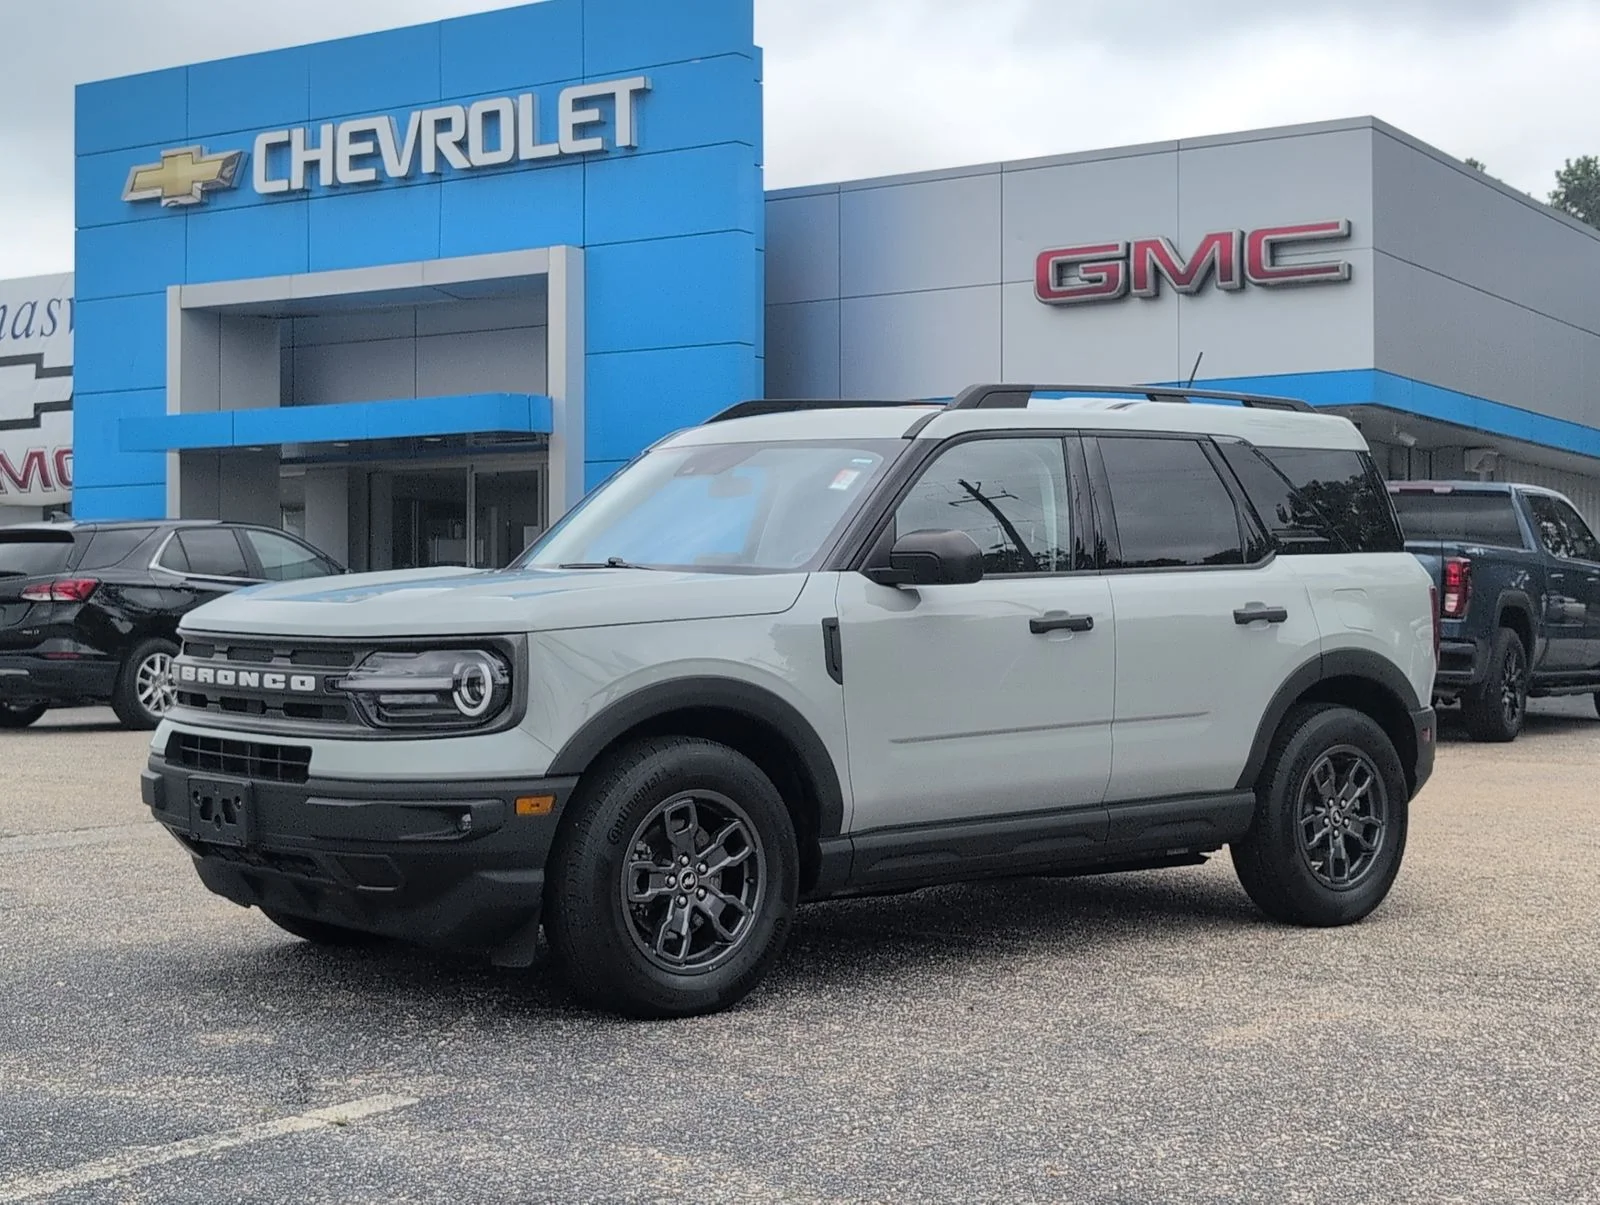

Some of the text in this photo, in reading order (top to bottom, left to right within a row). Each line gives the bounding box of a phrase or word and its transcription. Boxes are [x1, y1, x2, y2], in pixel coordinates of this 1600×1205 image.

[253, 76, 652, 194] CHEVROLET
[1034, 218, 1351, 305] GMC
[181, 665, 316, 692] BRONCO
